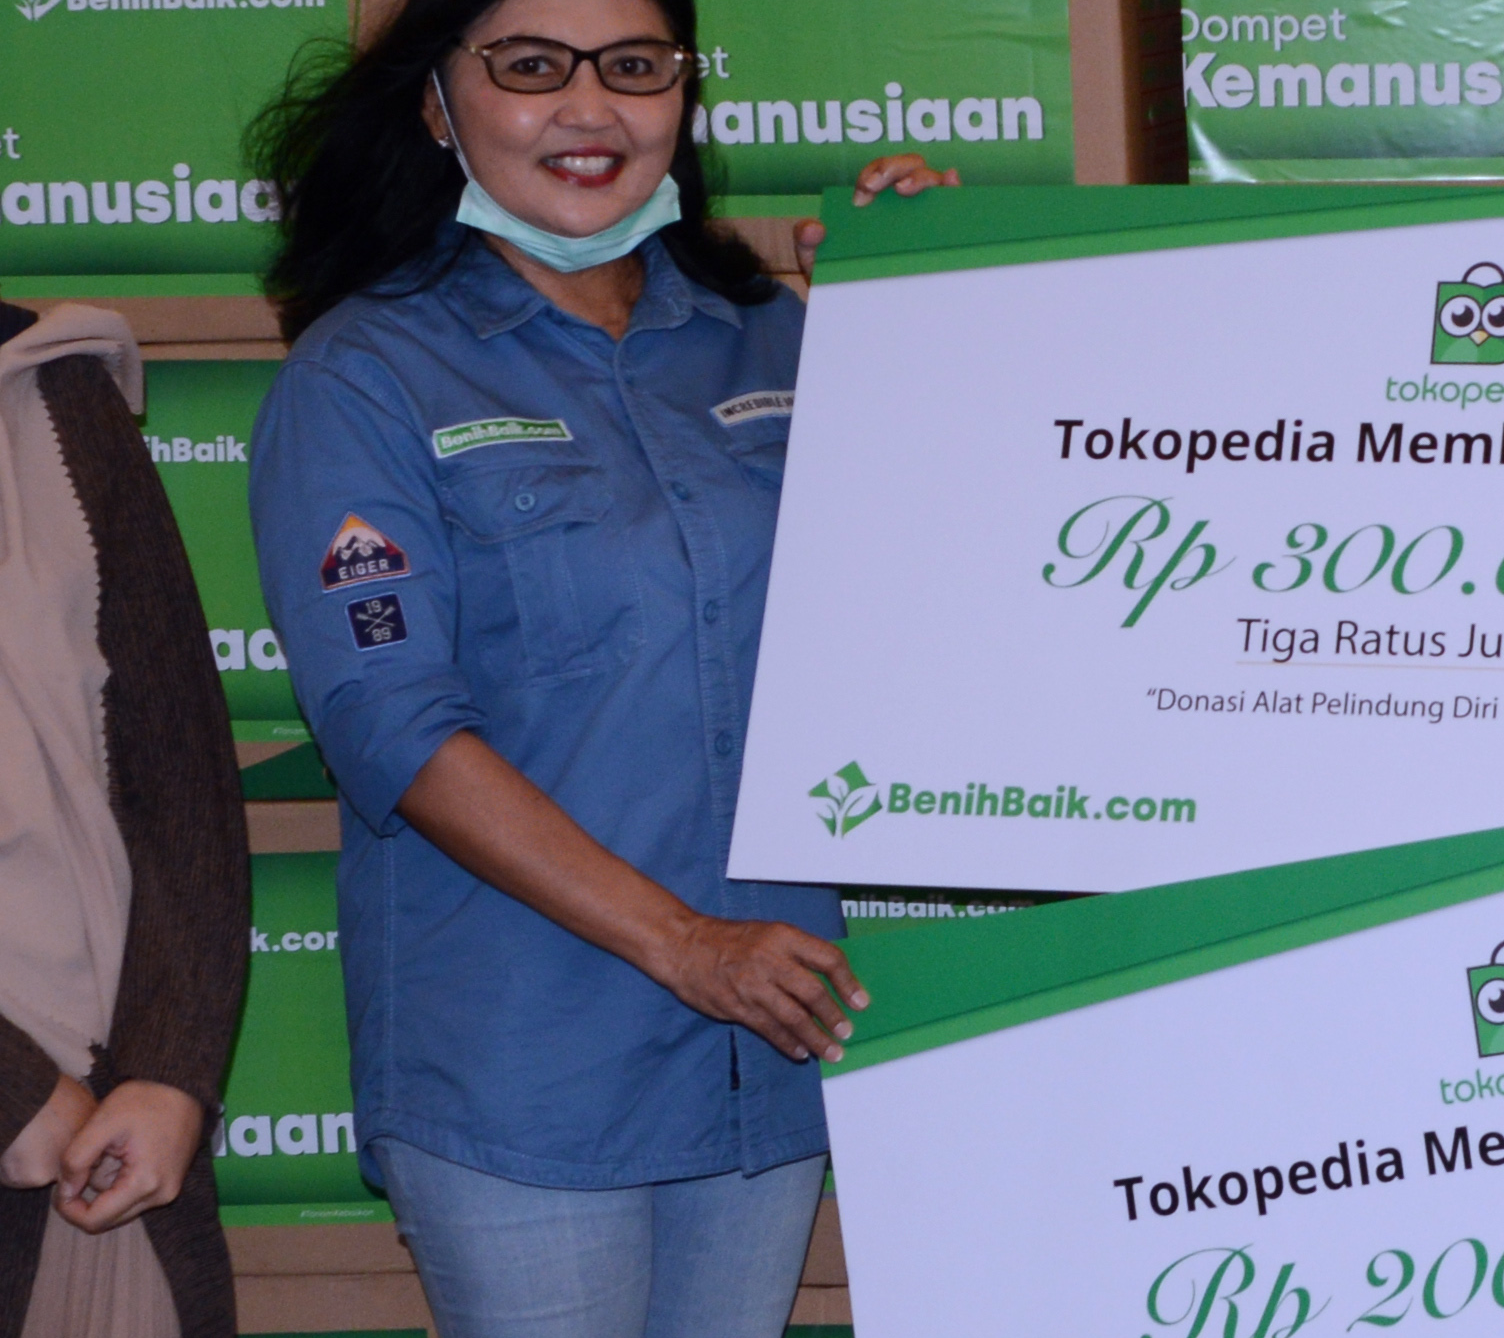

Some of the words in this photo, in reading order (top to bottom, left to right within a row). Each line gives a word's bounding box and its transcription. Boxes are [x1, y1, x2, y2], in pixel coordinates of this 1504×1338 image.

[1055, 418, 1334, 473] Tokopedia
[339, 559, 390, 580] EIGER
[1042, 495, 1236, 628] Rp
[365, 601, 382, 615] 19
[371, 627, 391, 642] 89
[1238, 618, 1319, 664] Tiga
[1335, 620, 1445, 657] Ratus
[1147, 688, 1244, 712] “Donasi
[1252, 691, 1303, 714] Alat
[1311, 692, 1444, 724] Pelindung
[1453, 696, 1497, 719] Diri
[888, 783, 1196, 822] BenihBaik.com
[1114, 1140, 1404, 1220] Tokopedia
